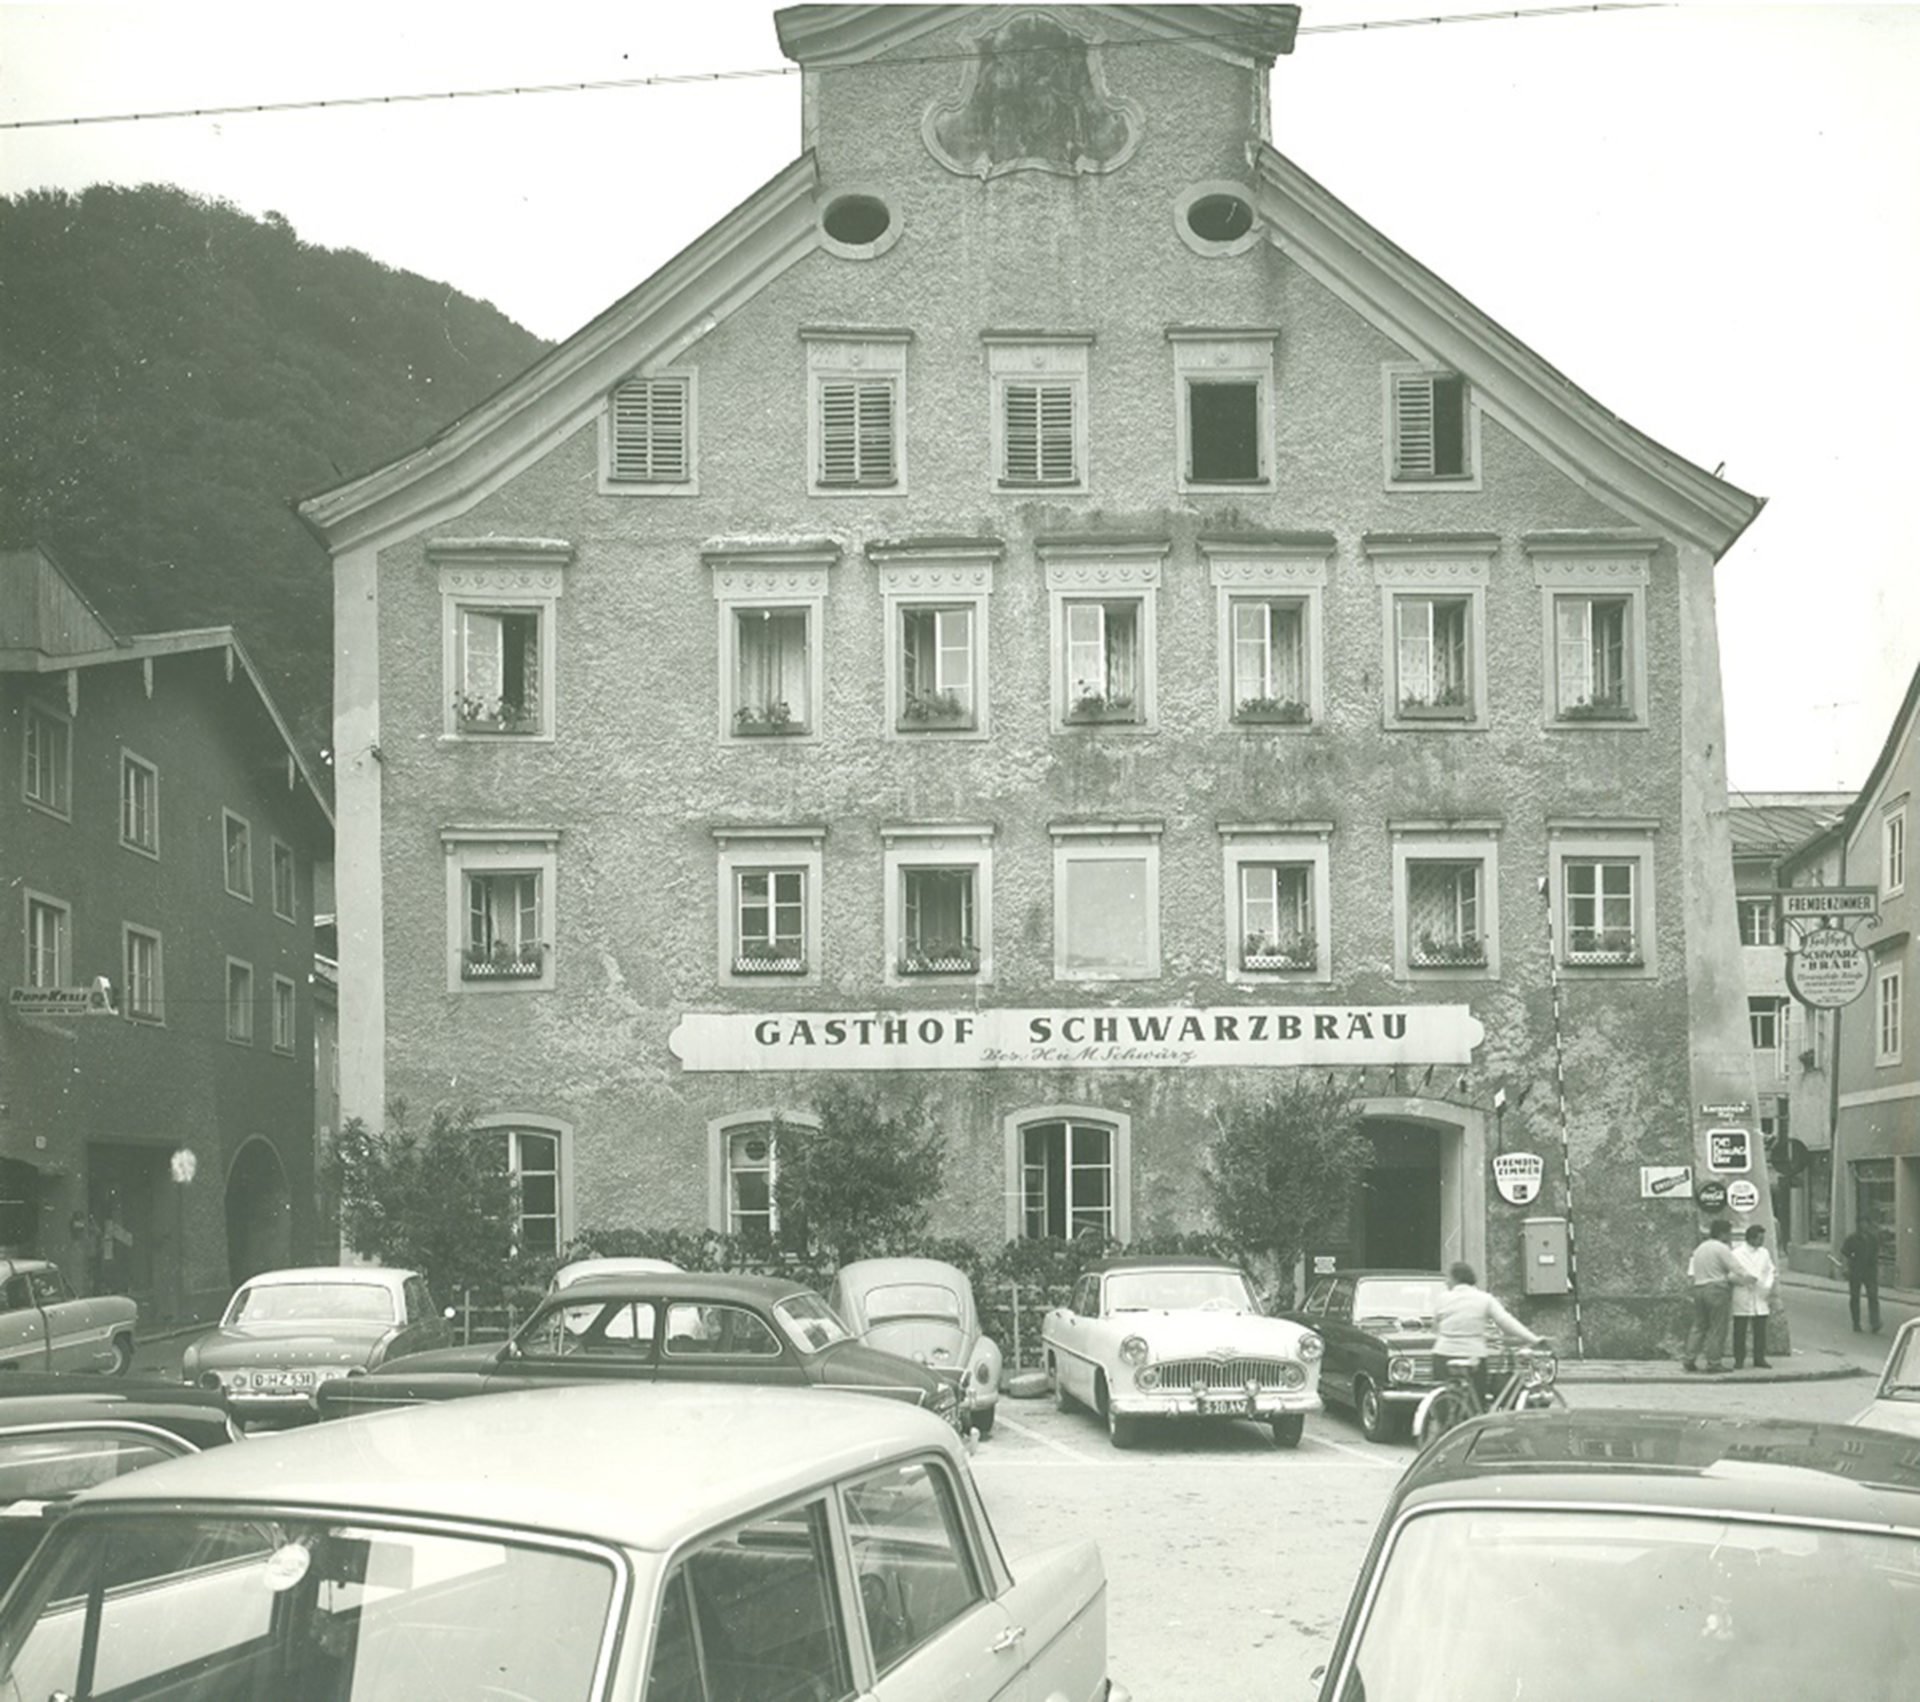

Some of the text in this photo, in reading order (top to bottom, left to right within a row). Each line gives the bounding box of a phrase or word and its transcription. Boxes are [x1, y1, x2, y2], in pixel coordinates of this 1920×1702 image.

[1788, 896, 1872, 911] FREMDENZIMMER
[754, 1011, 1408, 1046] GASTHOF SCHWARZBRÄU
[1496, 1158, 1540, 1167] FREMDEN
[1498, 1166, 1540, 1176] ZIMMER
